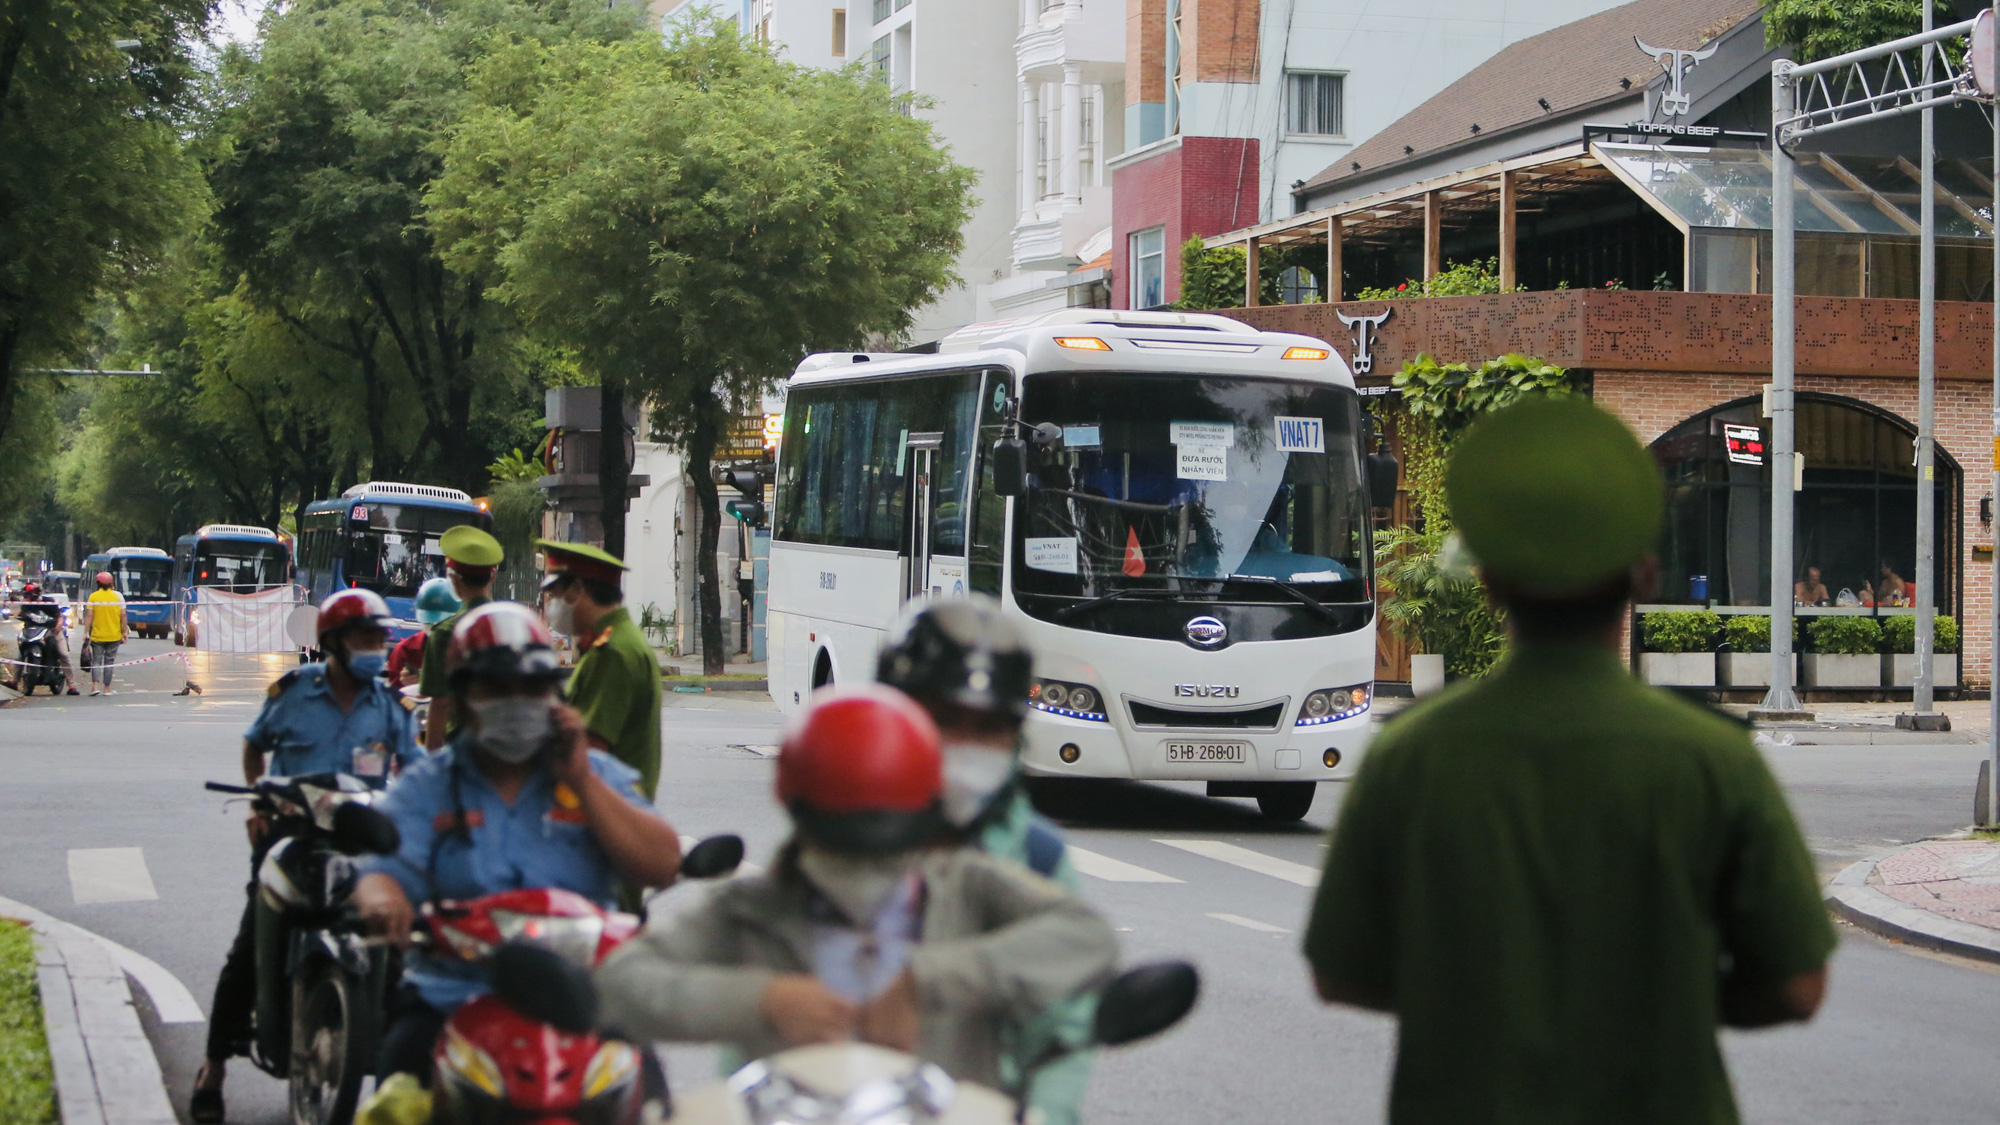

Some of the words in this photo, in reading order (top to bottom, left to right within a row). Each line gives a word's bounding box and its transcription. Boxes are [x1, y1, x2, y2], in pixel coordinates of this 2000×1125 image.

[1635, 122, 1686, 135] TOPPING
[1687, 125, 1720, 136] BEEF
[1368, 386, 1390, 395] BEEF
[1278, 420, 1310, 448] VNAT
[1182, 455, 1200, 463] ĐƯA
[1201, 455, 1224, 464] RƯỚC
[1181, 465, 1204, 474] NHÂN
[1205, 467, 1224, 475] VIÊN
[354, 507, 367, 519] 93
[1189, 627, 1224, 635] SAMCO
[1174, 683, 1240, 698] ISUZU
[1169, 744, 1241, 760] 51B-268.01
